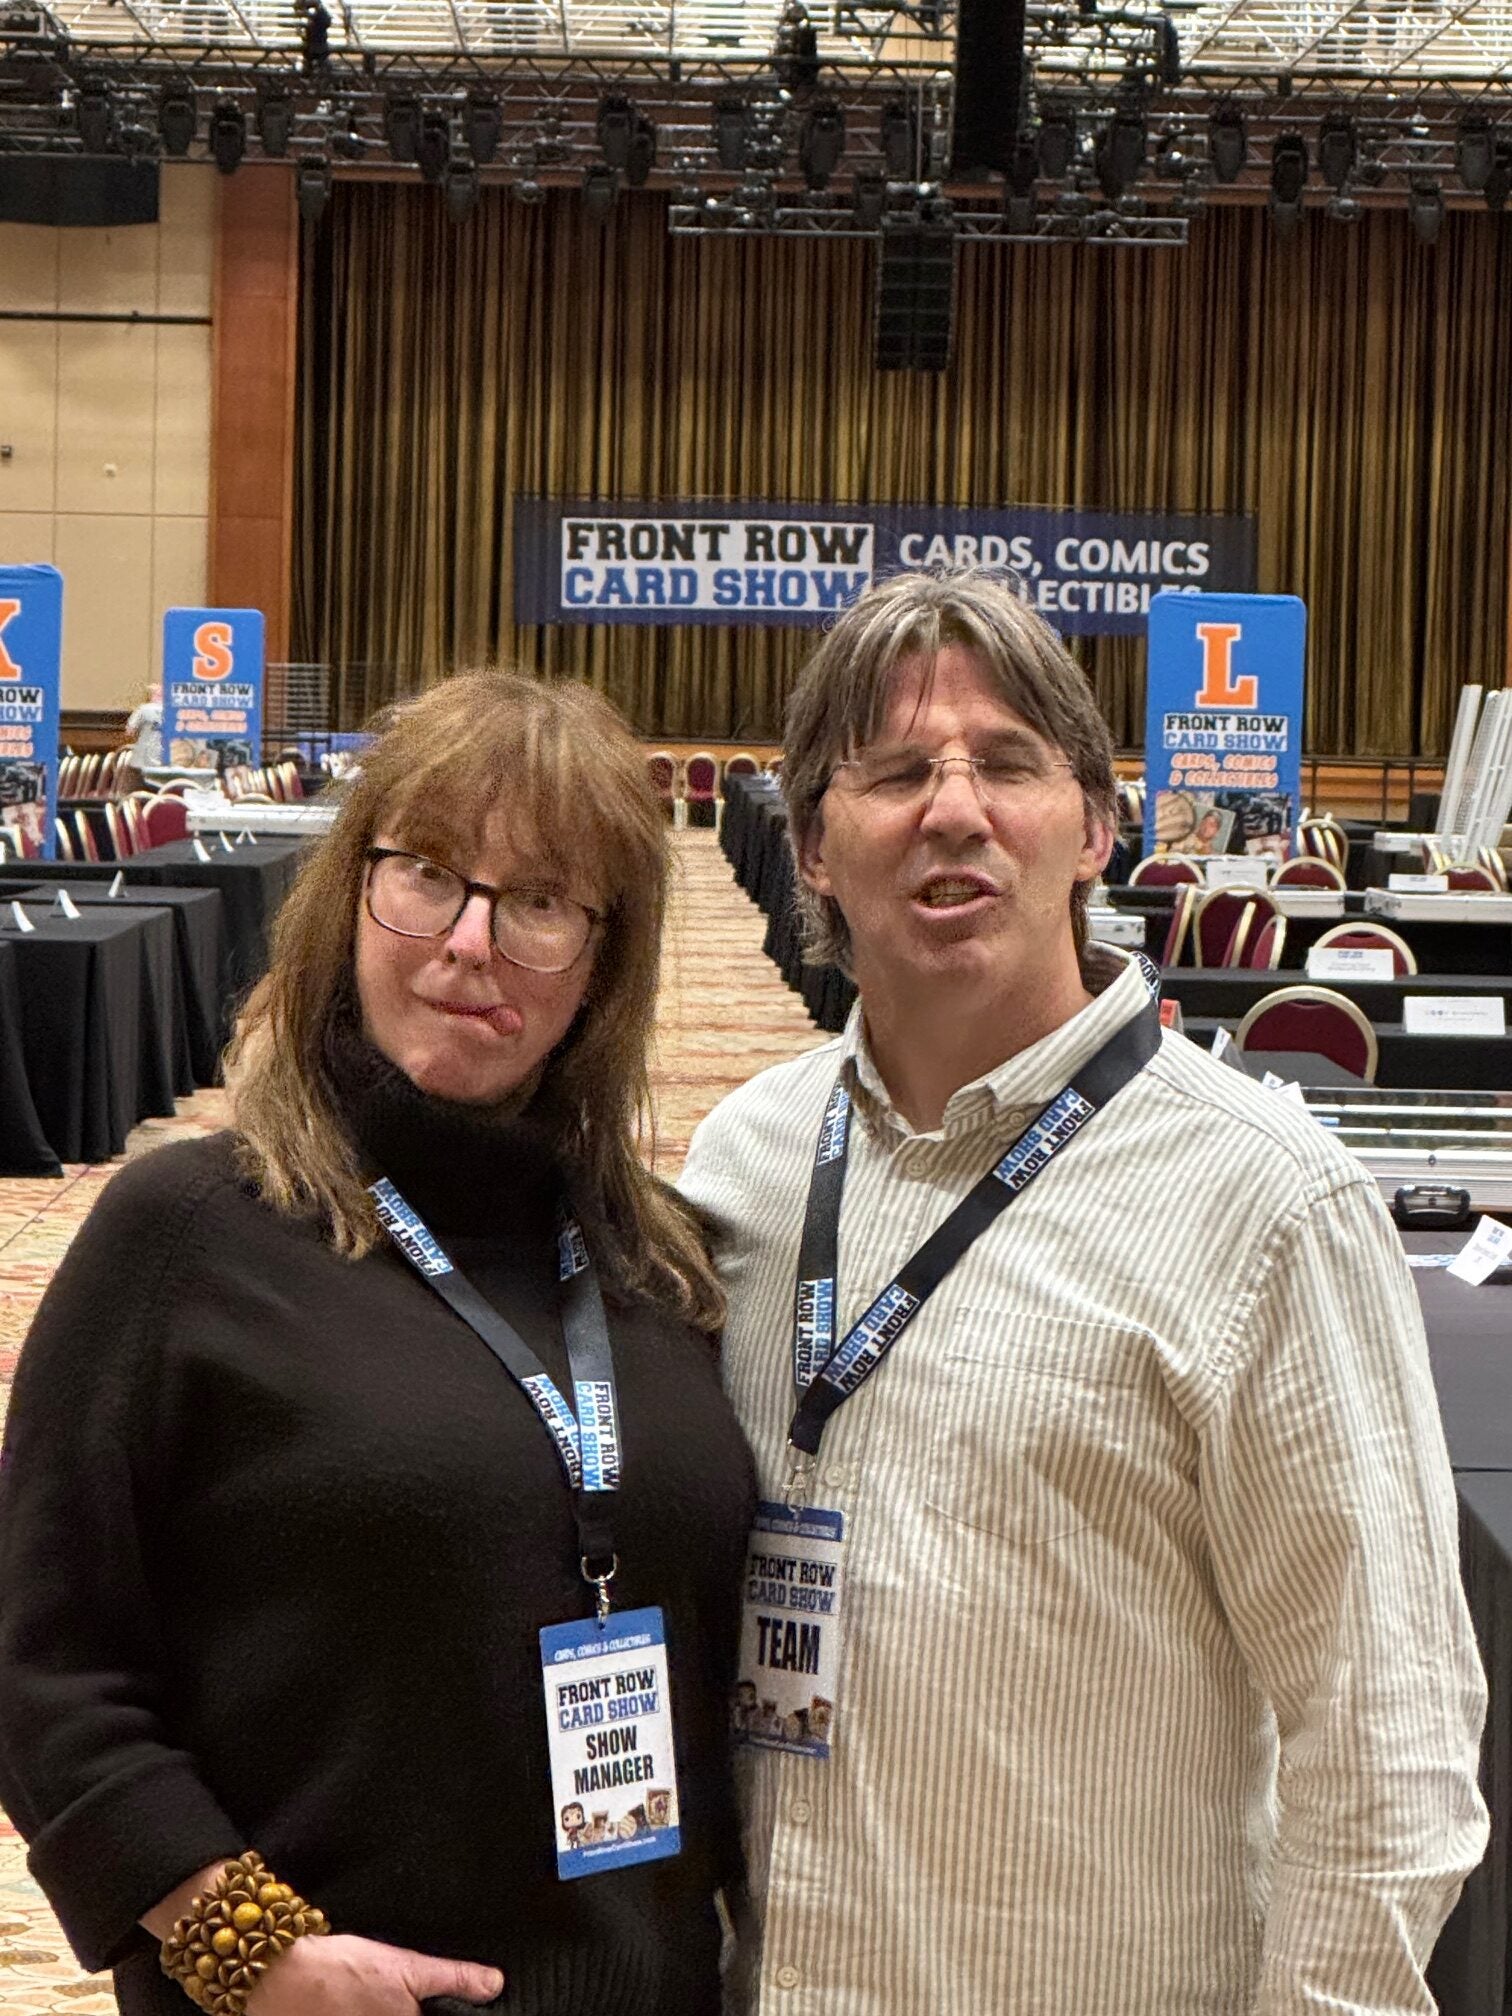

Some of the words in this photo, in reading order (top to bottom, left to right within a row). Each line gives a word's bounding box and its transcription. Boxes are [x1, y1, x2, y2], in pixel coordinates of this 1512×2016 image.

[567, 522, 729, 561] FRONT
[744, 523, 868, 564] ROW
[900, 533, 1042, 575] CARDS,
[1054, 537, 1210, 576] COMICS
[565, 567, 698, 605] CARD
[713, 568, 869, 608] SHOW
[192, 621, 233, 681] S
[1195, 622, 1258, 709] L
[0, 688, 40, 704] OW
[1165, 732, 1218, 749] CARD
[1224, 734, 1286, 750] SHOW
[1166, 714, 1230, 731] FRONT
[1236, 716, 1285, 733] ROW
[1039, 1089, 1080, 1132] CARD
[1044, 1100, 1094, 1152] FRONT
[997, 1130, 1042, 1180] SHOW
[1009, 1147, 1050, 1188] ROW
[799, 1283, 815, 1323] ROW
[816, 1281, 833, 1334] SHOW
[864, 1286, 905, 1332] CARD
[871, 1294, 918, 1352] FRONT
[798, 1326, 814, 1384] FRONT
[824, 1330, 869, 1384] SHOW
[838, 1349, 877, 1391] ROW
[524, 1380, 558, 1421] ROW
[577, 1382, 596, 1427] CARD
[595, 1383, 614, 1438] FRONT
[582, 1432, 601, 1489] SHOW
[600, 1443, 620, 1489] ROW
[752, 1554, 797, 1582] FRONT
[799, 1561, 836, 1588] ROW
[748, 1580, 787, 1605] CARD
[789, 1586, 836, 1613] SHOW
[757, 1616, 821, 1675] TEAM
[558, 1678, 611, 1706] FRONT
[615, 1668, 655, 1695] ROW
[560, 1702, 604, 1729] CARD
[607, 1691, 657, 1720] SHOW
[586, 1725, 637, 1760] SHOW
[574, 1754, 654, 1795] MANAGER
